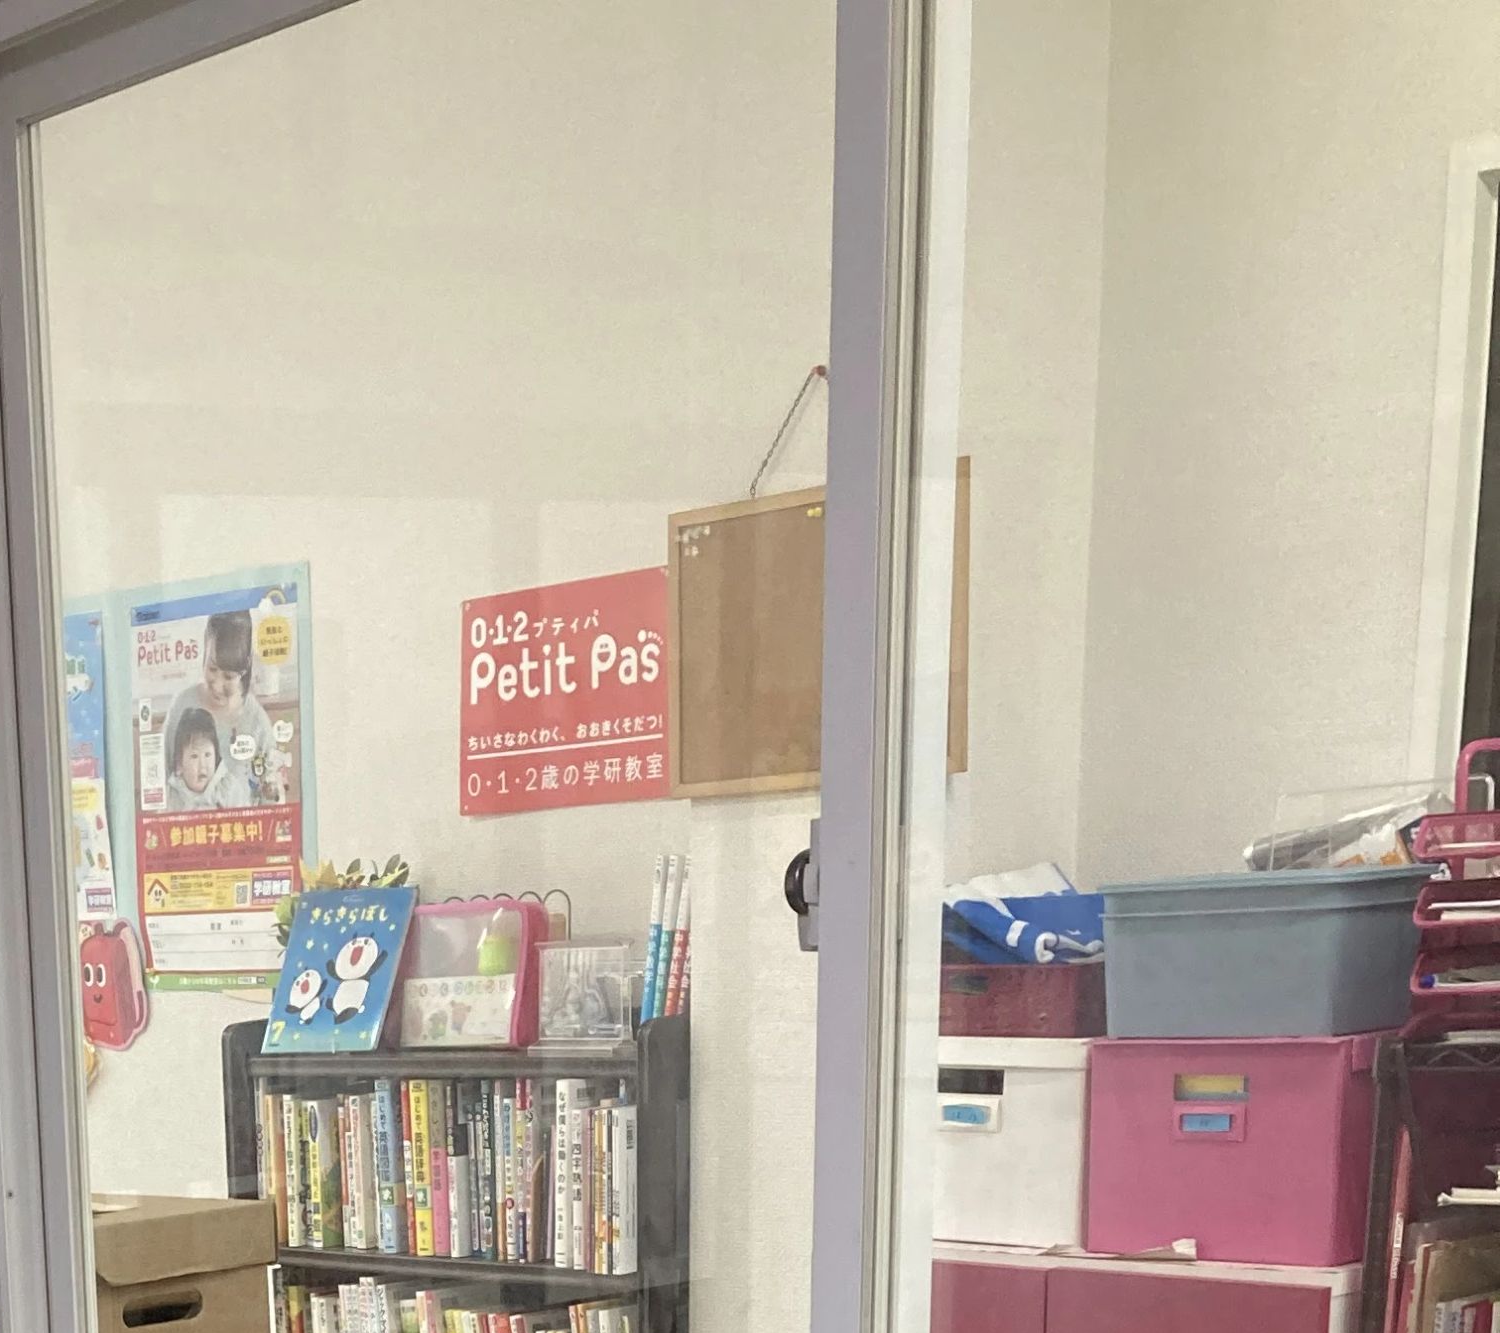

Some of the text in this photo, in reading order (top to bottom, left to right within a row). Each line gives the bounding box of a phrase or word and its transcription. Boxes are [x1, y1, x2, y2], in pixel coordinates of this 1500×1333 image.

[138, 640, 198, 667] Petit Pas
[470, 631, 661, 705] Petit Pas
[310, 904, 389, 925] きらきらぼし
